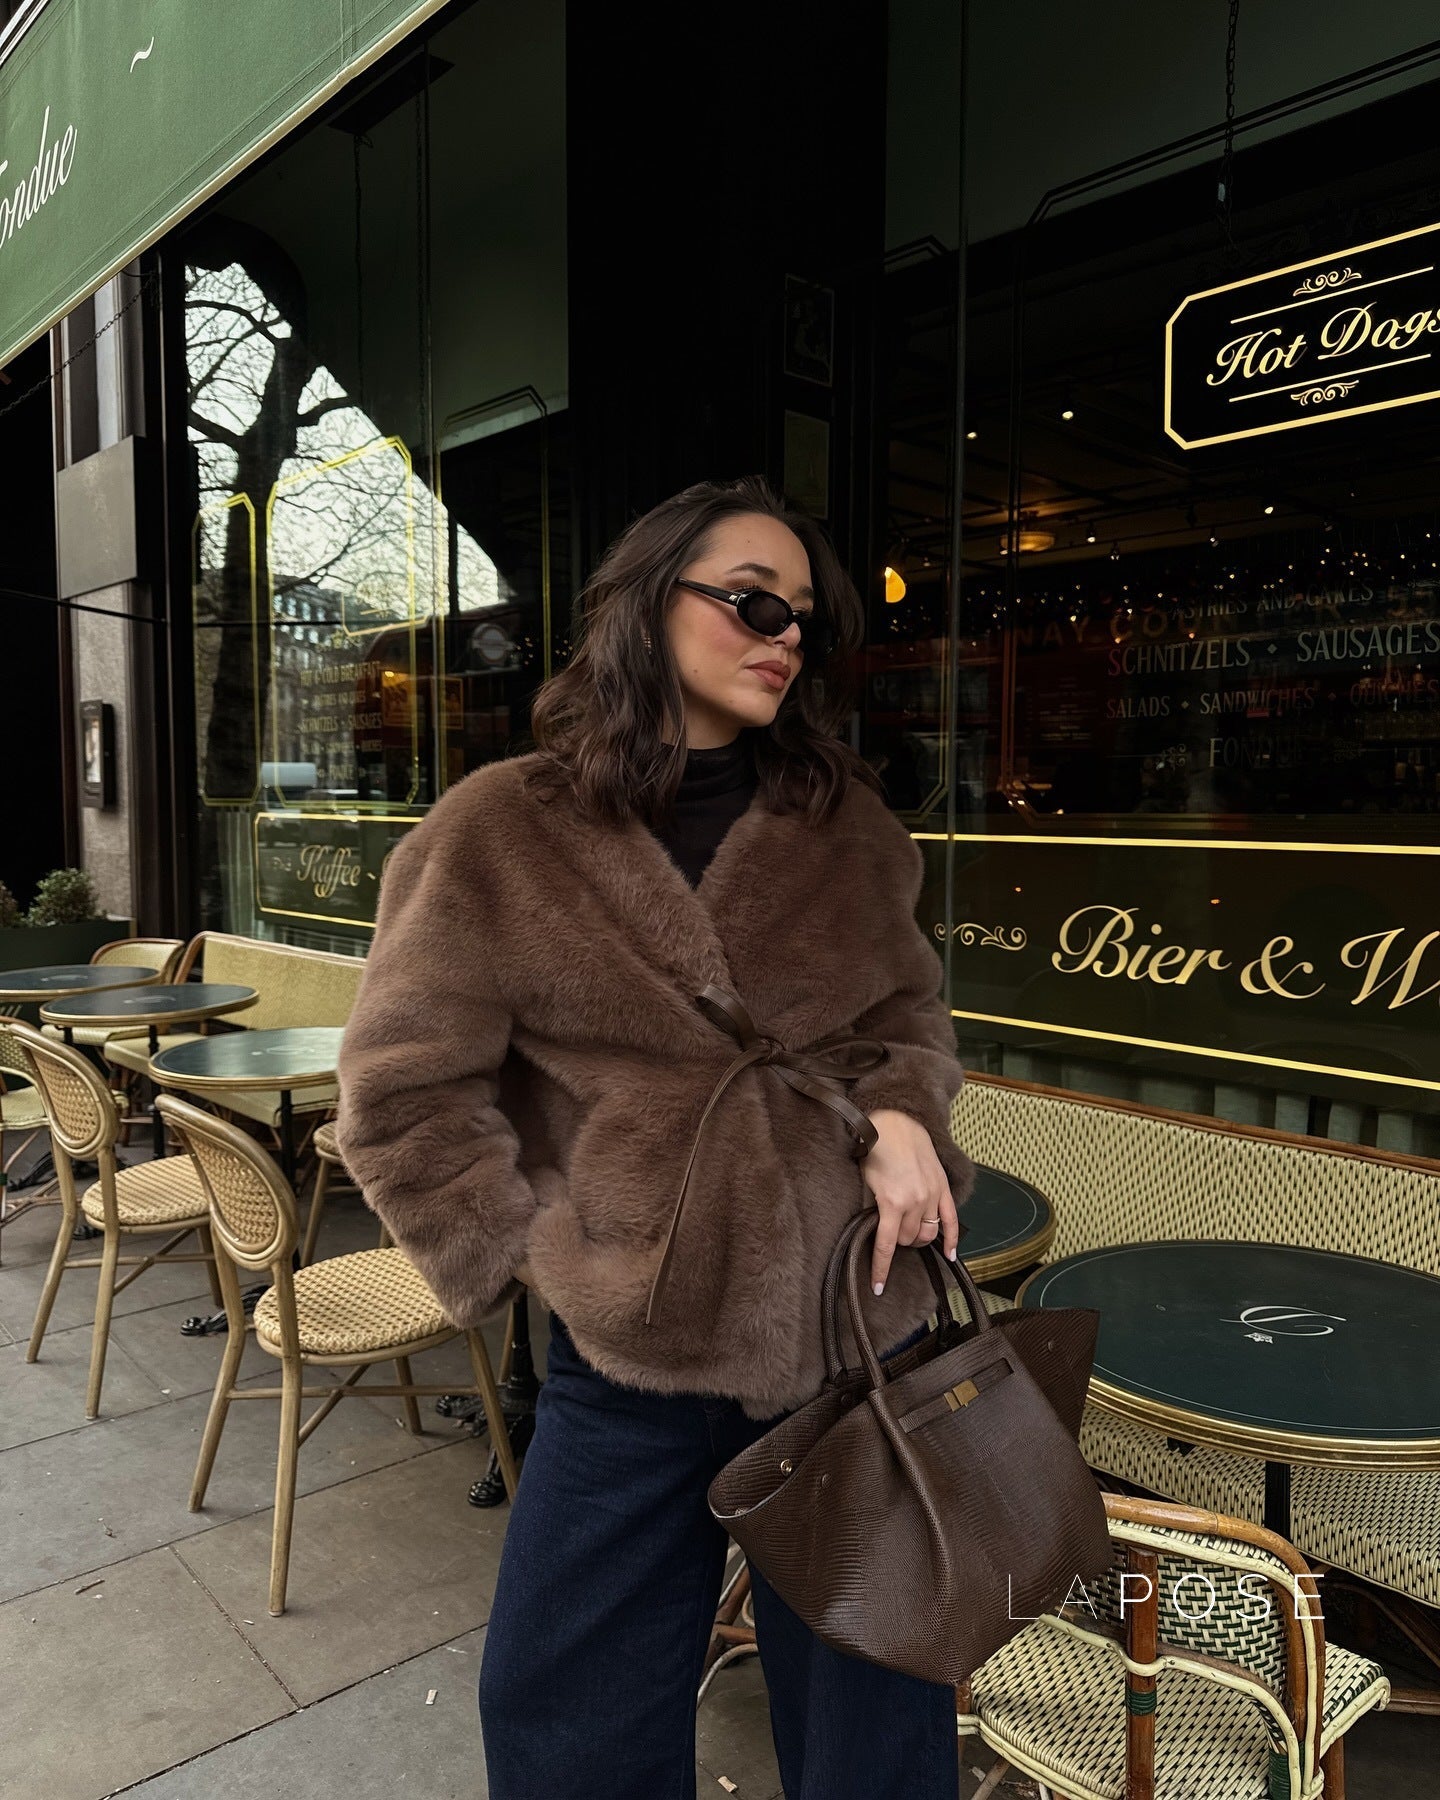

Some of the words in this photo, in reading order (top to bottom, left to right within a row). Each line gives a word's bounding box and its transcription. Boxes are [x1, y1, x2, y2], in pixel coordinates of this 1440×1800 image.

[0, 105, 78, 250] ondue
[1205, 326, 1308, 388] Hot
[1168, 591, 1248, 622] ASTRIES
[1256, 588, 1296, 612] AND
[1107, 638, 1251, 676] SCHNITZELS
[1296, 620, 1440, 663] SAUSAGES
[1106, 694, 1171, 720] SALADS
[1199, 686, 1316, 716] SANDWICHES
[297, 844, 361, 898] Kaffee
[1052, 904, 1231, 986] Bier
[1239, 935, 1326, 1000] &
[1340, 927, 1440, 1010] W
